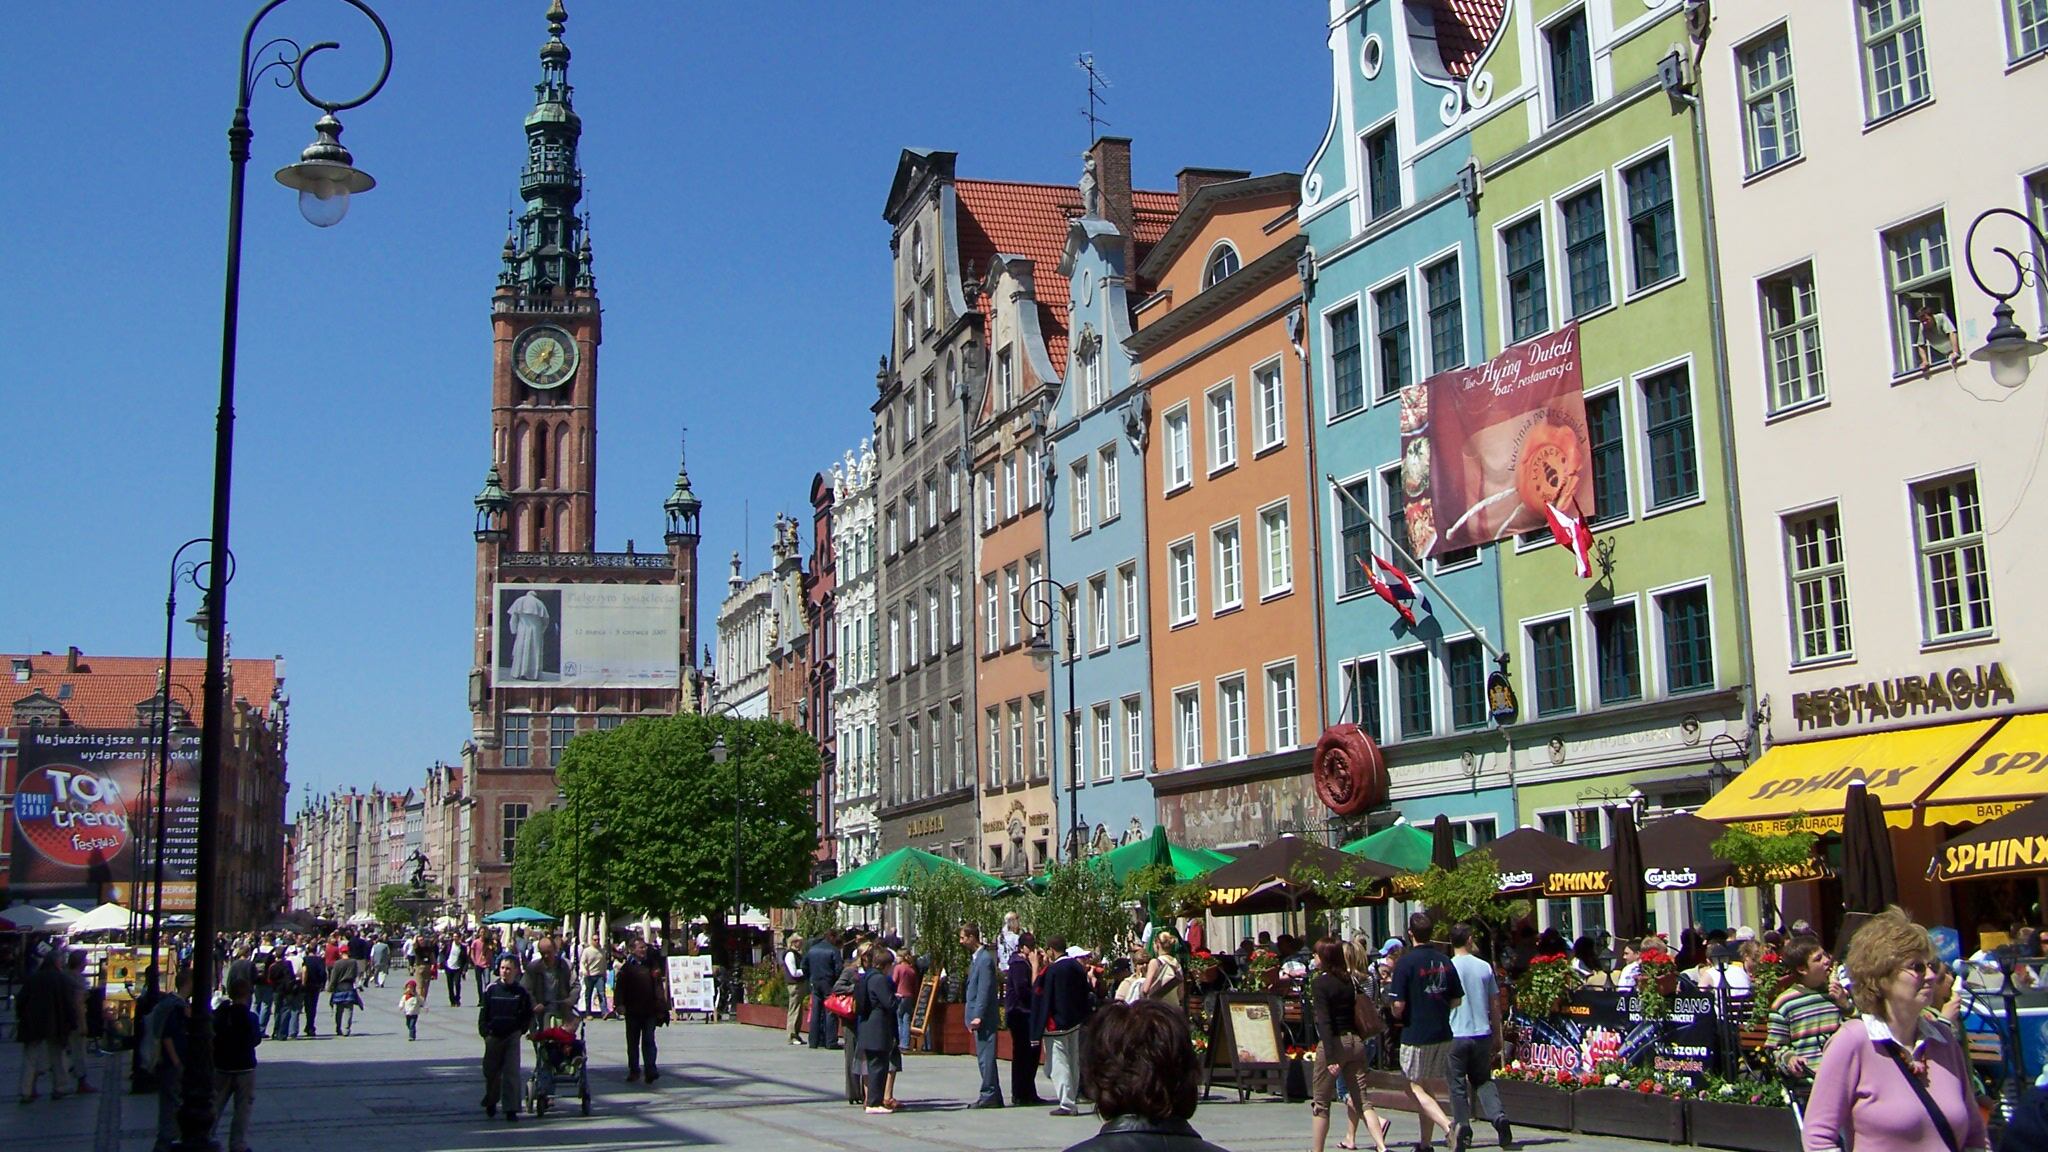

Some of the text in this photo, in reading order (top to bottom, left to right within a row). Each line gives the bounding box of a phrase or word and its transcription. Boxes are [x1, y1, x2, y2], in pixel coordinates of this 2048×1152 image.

[1477, 358, 1522, 391] Flying
[1528, 329, 1575, 366] Dutch
[1518, 358, 1573, 388] restauracja
[1791, 661, 2014, 726] RESTAURACJA
[36, 732, 135, 747] Najważniejsze
[46, 769, 120, 806] TOP
[1748, 766, 1918, 799] SPHINX
[21, 805, 46, 816] 2007
[51, 806, 128, 833] trendy
[1977, 805, 2003, 816] BAR
[1772, 816, 1845, 831] RESAURACJA
[72, 834, 119, 851] festiwal
[1946, 835, 2048, 874] SPHINX
[1548, 872, 1607, 891] SPHINX
[1644, 867, 1697, 888] Carlsberg
[1674, 998, 1711, 1013] BANG
[1520, 1042, 1577, 1070] OLLING
